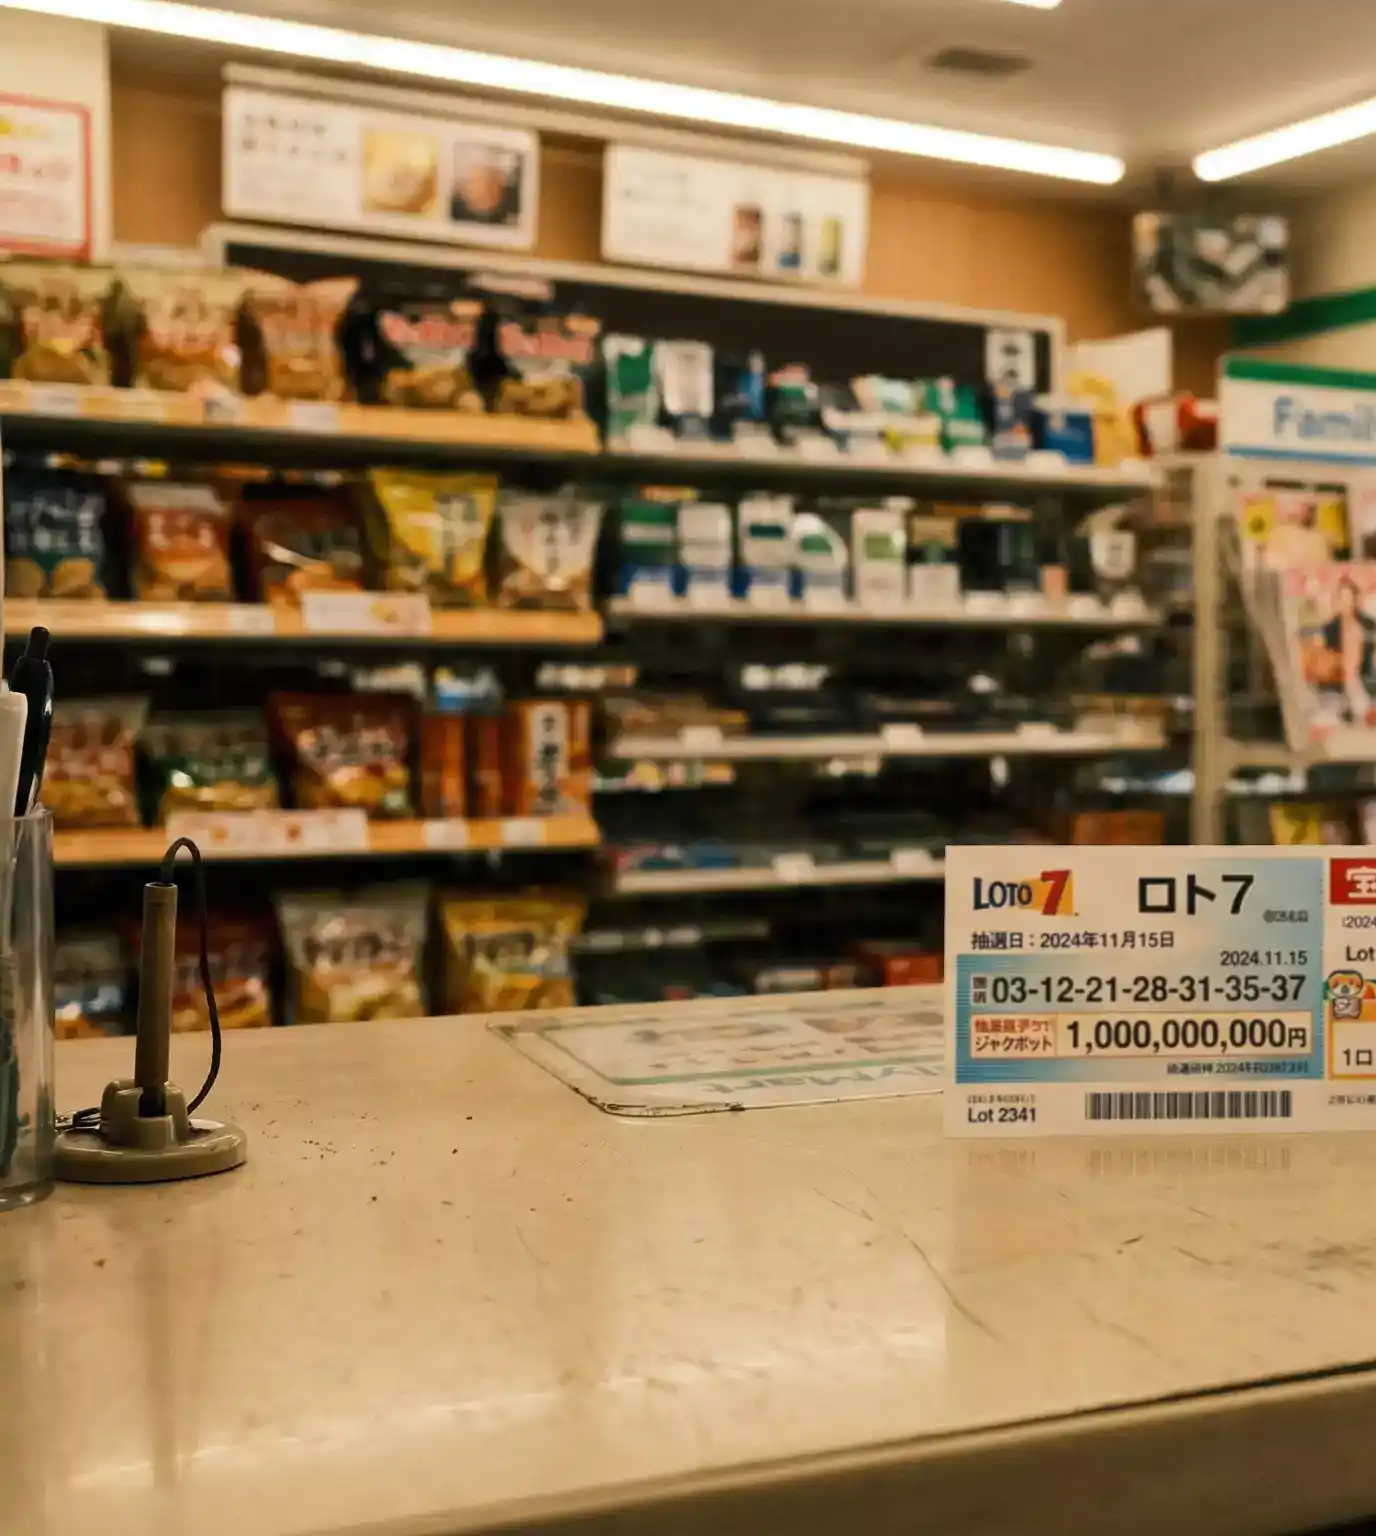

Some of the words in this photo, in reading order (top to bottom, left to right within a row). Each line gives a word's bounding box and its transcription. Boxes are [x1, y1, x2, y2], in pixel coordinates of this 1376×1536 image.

[973, 877, 1033, 910] LOTO
[1040, 870, 1072, 915] 7
[1139, 874, 1254, 915] ロト7
[1220, 951, 1307, 966] 2024.11.15
[1346, 946, 1375, 962] Lot
[992, 975, 1306, 1002] 03-12-21-28-31-35-37
[1066, 1019, 1306, 1053] 1,000,000,000円
[968, 1108, 994, 1122] Lot
[998, 1107, 1036, 1122] 2341
